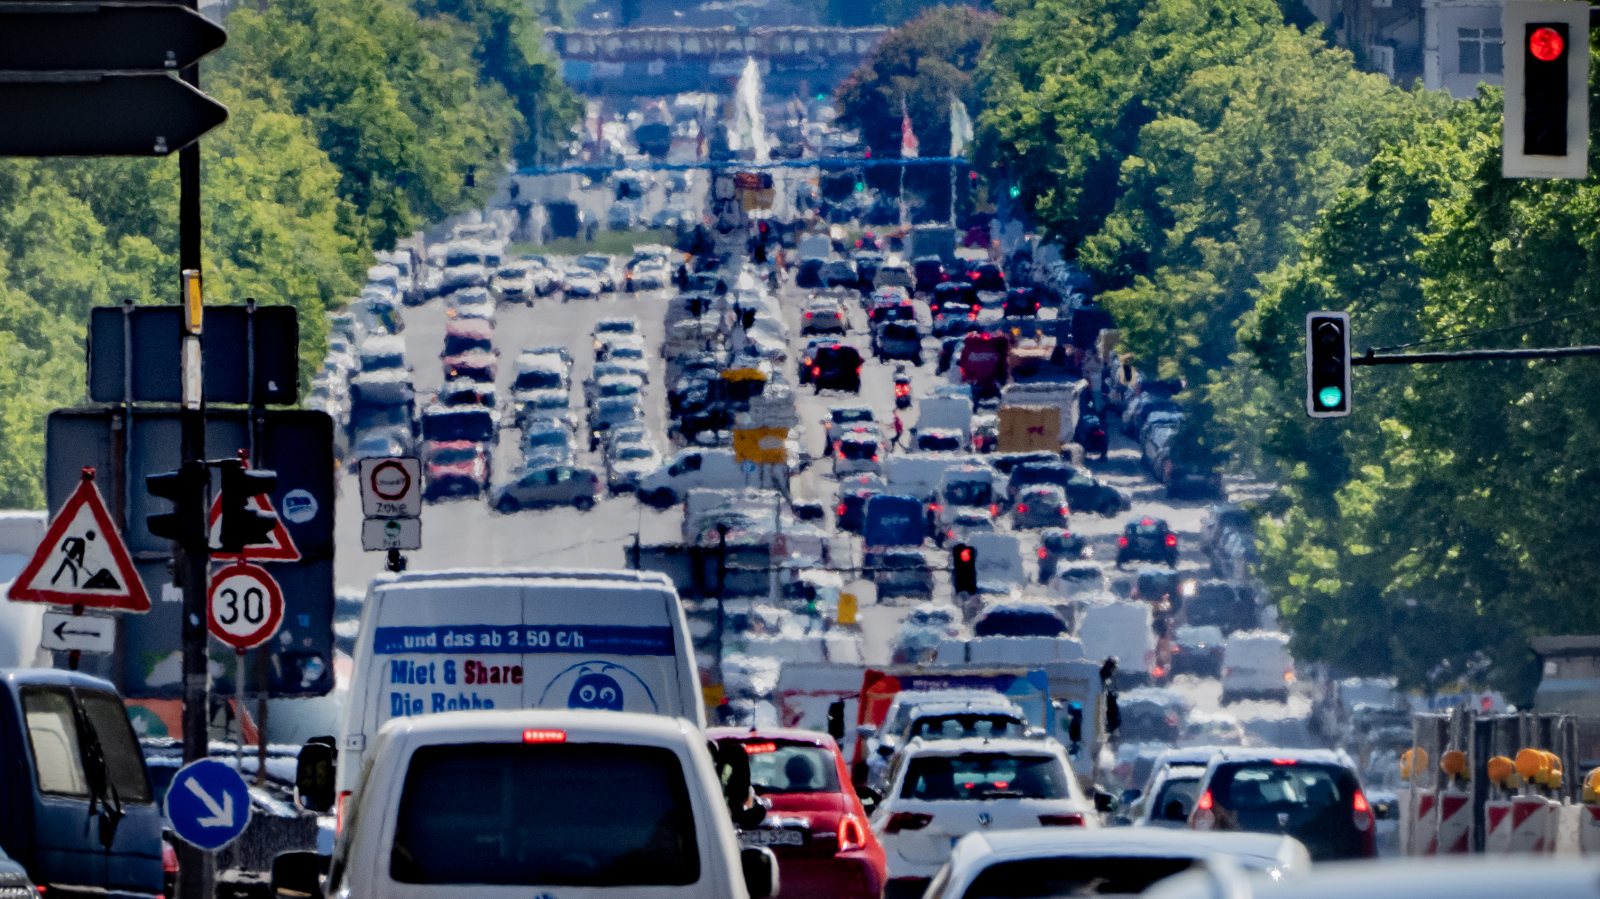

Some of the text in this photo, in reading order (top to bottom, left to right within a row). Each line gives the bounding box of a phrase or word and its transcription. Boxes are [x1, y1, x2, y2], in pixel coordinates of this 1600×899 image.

[220, 587, 264, 625] 30
[443, 630, 475, 648] das
[480, 630, 502, 647] ab
[391, 660, 436, 684] Miet
[464, 660, 523, 685] Share
[391, 692, 424, 716] Die
